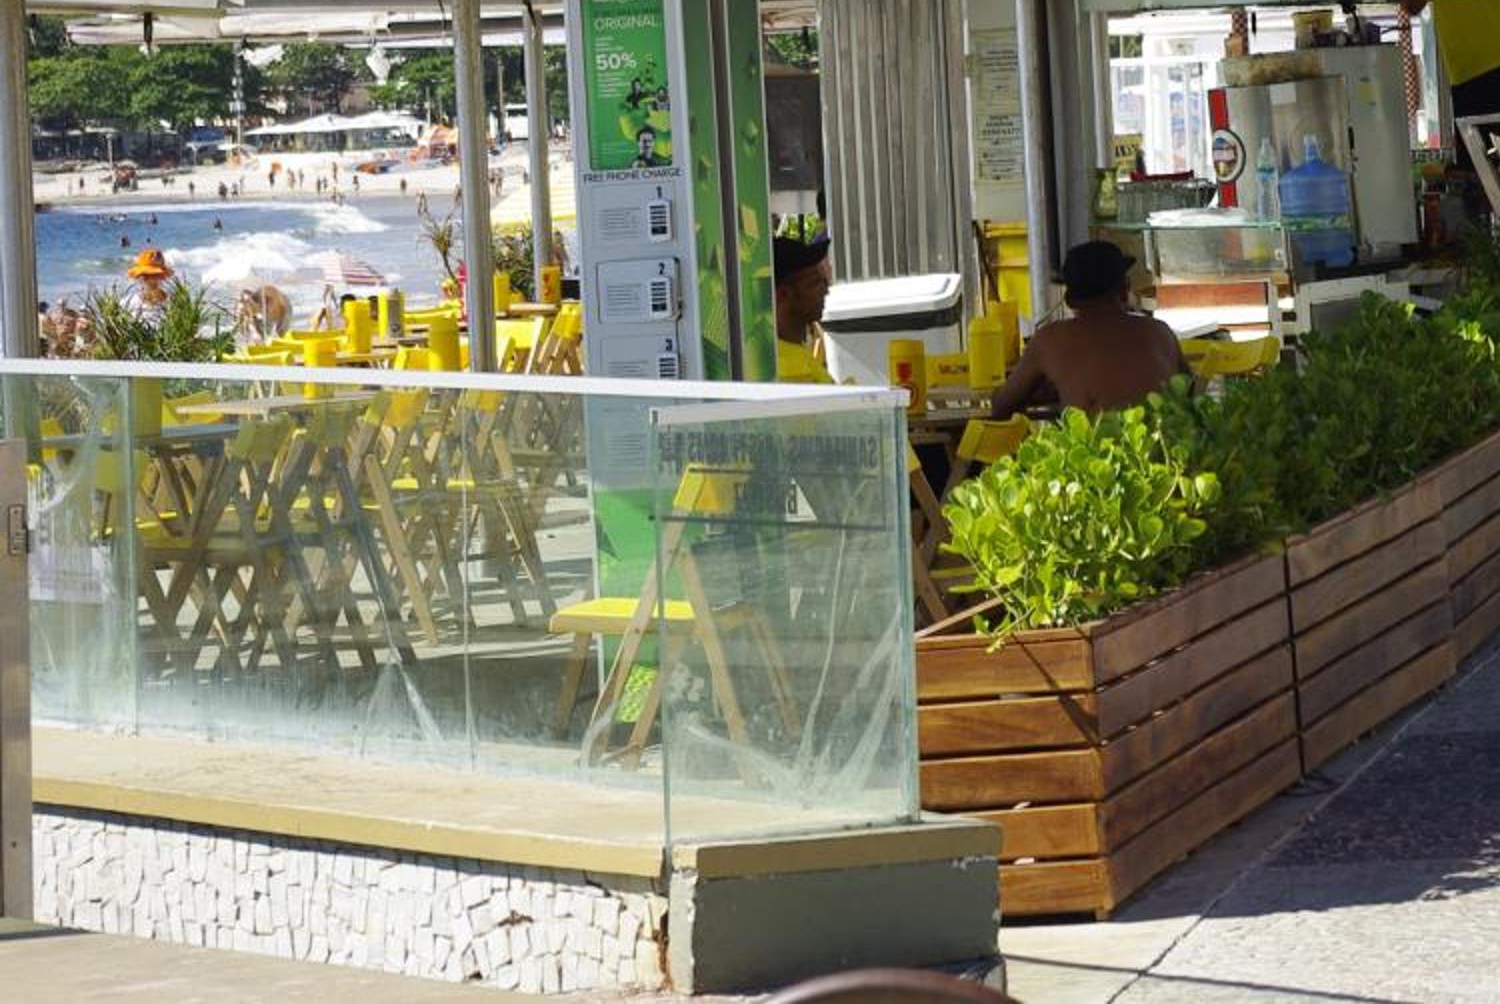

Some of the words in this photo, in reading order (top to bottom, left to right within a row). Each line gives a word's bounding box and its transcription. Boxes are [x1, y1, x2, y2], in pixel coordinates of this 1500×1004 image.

[593, 16, 659, 31] ORIGINAL
[596, 52, 637, 71] 50%
[607, 169, 638, 181] PHONE
[641, 167, 681, 179] CHARGE
[658, 262, 666, 276] 2
[665, 337, 673, 352] 3
